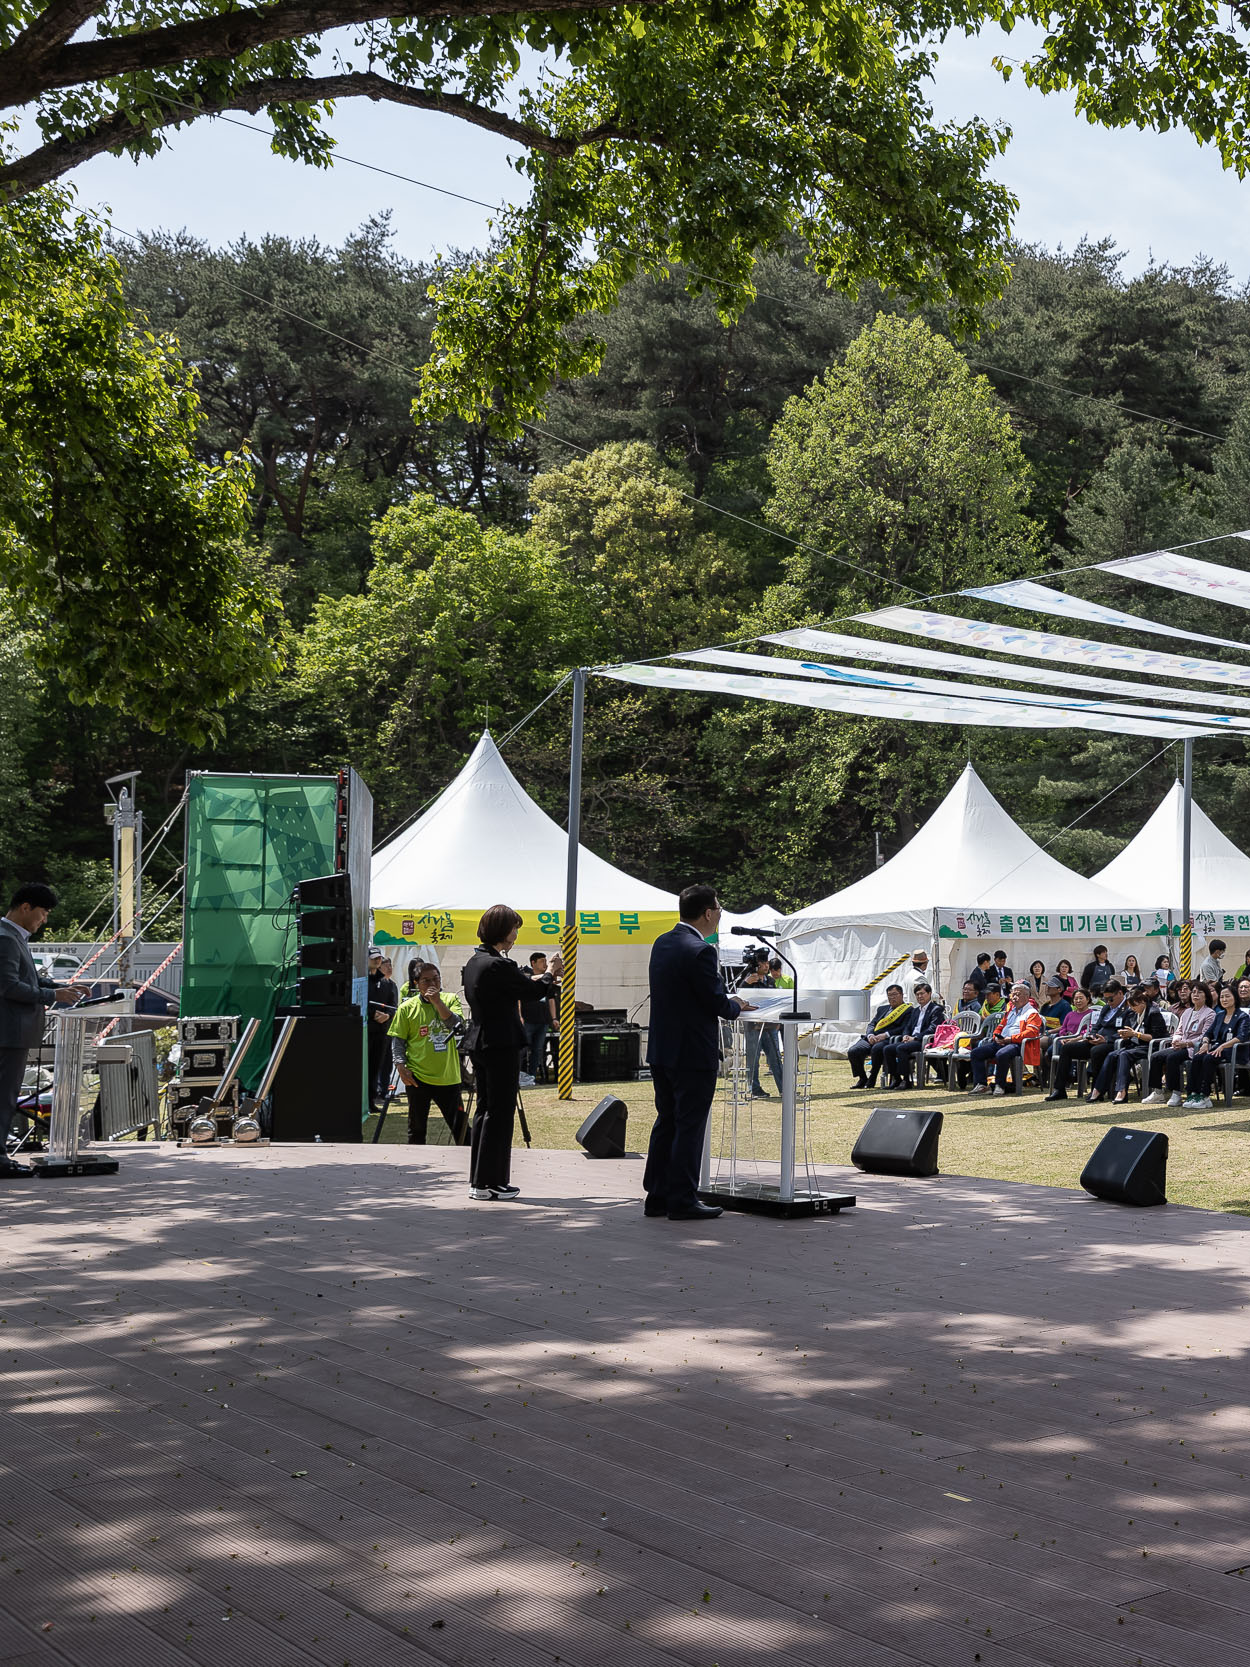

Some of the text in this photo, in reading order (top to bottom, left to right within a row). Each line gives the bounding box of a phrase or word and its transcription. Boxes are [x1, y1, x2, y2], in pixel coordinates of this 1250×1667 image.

[417, 911, 455, 933] 산나물
[999, 914, 1143, 933] 출연진 대기실(남)
[430, 928, 453, 944] 축제
